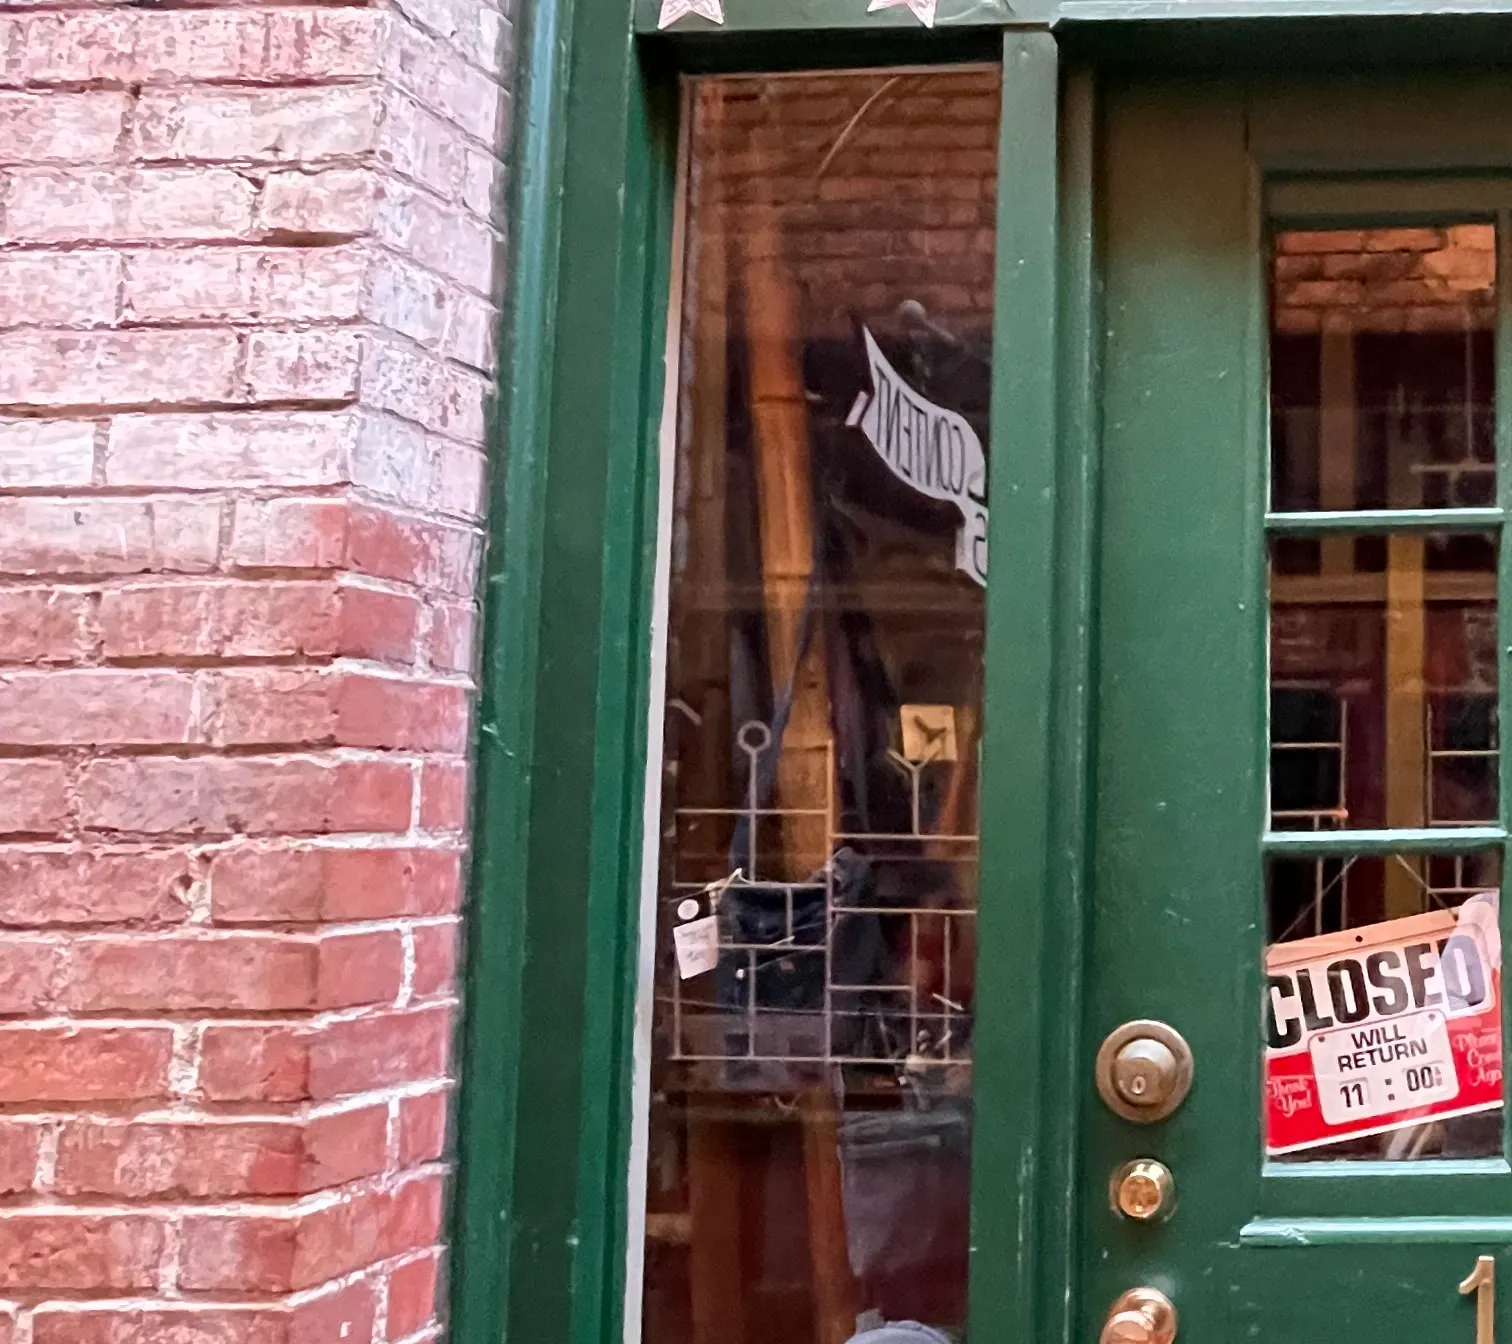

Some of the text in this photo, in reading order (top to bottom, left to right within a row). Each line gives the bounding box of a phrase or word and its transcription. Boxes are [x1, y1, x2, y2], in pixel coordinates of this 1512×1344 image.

[1266, 934, 1487, 1049] CLOSED
[1351, 1023, 1407, 1049] WILL
[1337, 1037, 1428, 1073] RETURN
